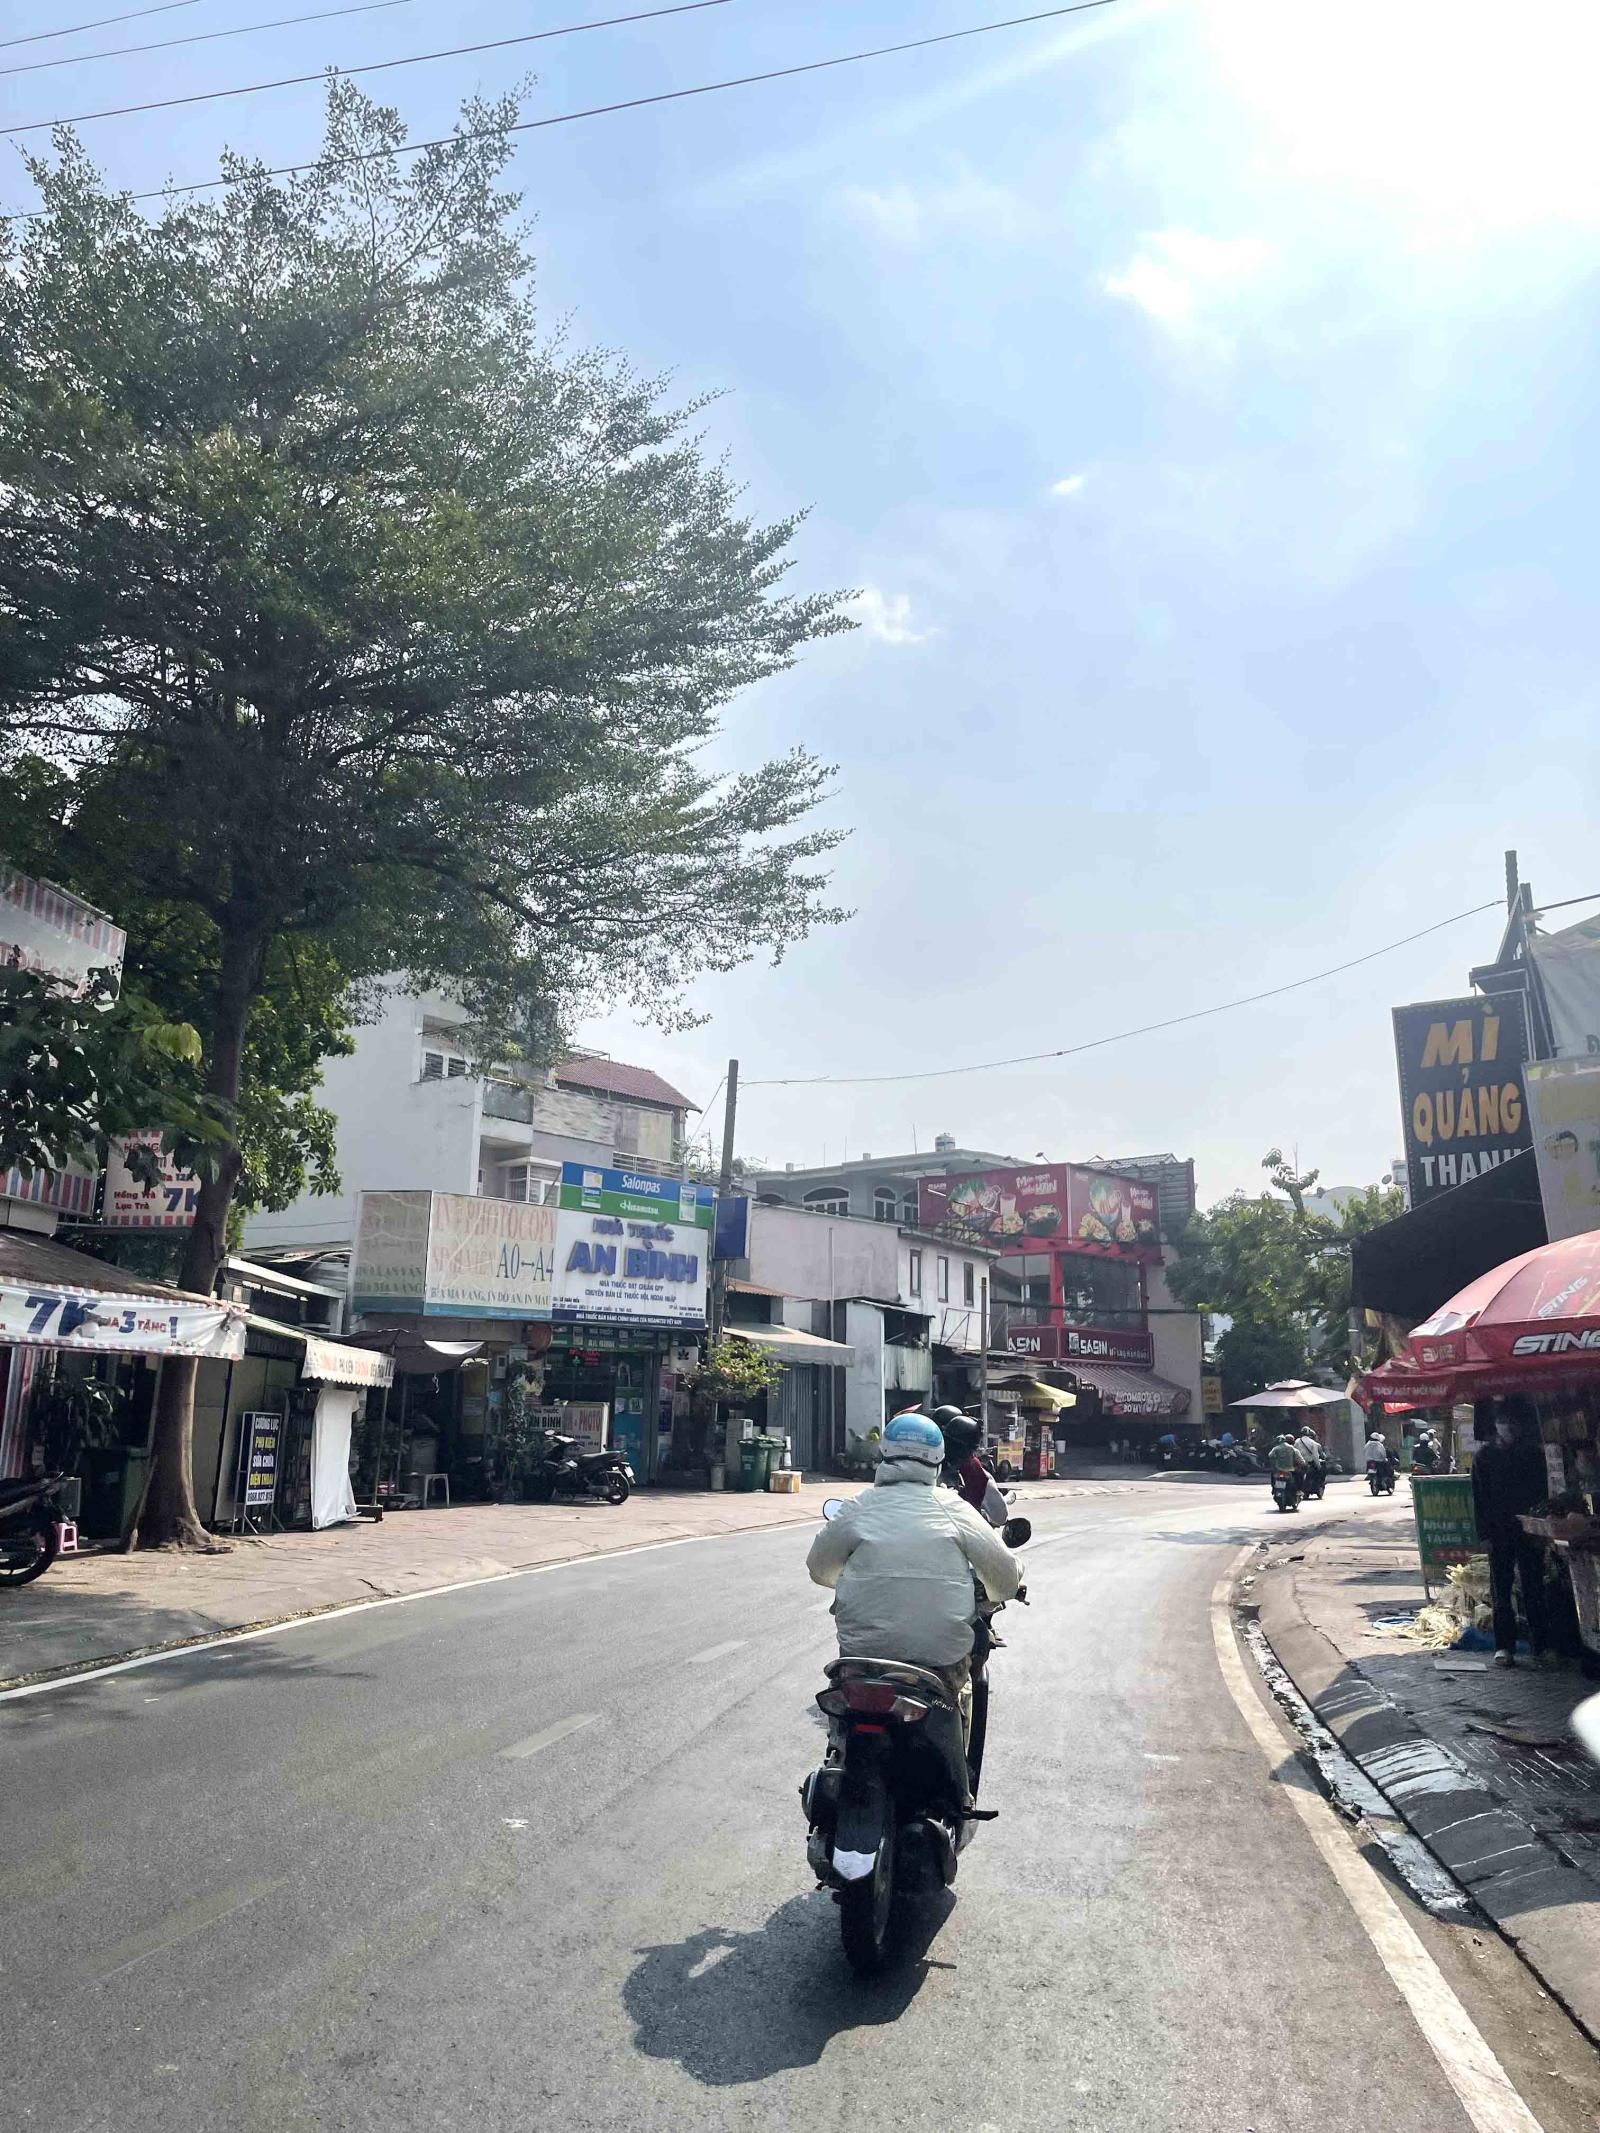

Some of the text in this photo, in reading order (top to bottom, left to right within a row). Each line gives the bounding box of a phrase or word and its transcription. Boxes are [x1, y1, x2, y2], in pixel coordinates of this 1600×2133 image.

[1420, 1003, 1500, 1069] MÌ
[1412, 1067, 1522, 1149] QUẢNG
[621, 1174, 661, 1195] Salonpas
[1419, 1147, 1522, 1188] THAN
[626, 1221, 675, 1243] THUỐC
[565, 1239, 699, 1284] AN BÌNH
[25, 1295, 98, 1338] 7K
[118, 1310, 137, 1334] 3
[137, 1318, 167, 1334] TẶNG
[169, 1316, 179, 1339] 1
[1537, 1275, 1589, 1318] STING
[1007, 1336, 1041, 1352] ASIN
[1080, 1338, 1108, 1355] SASIN
[542, 1413, 562, 1428] BÌNH
